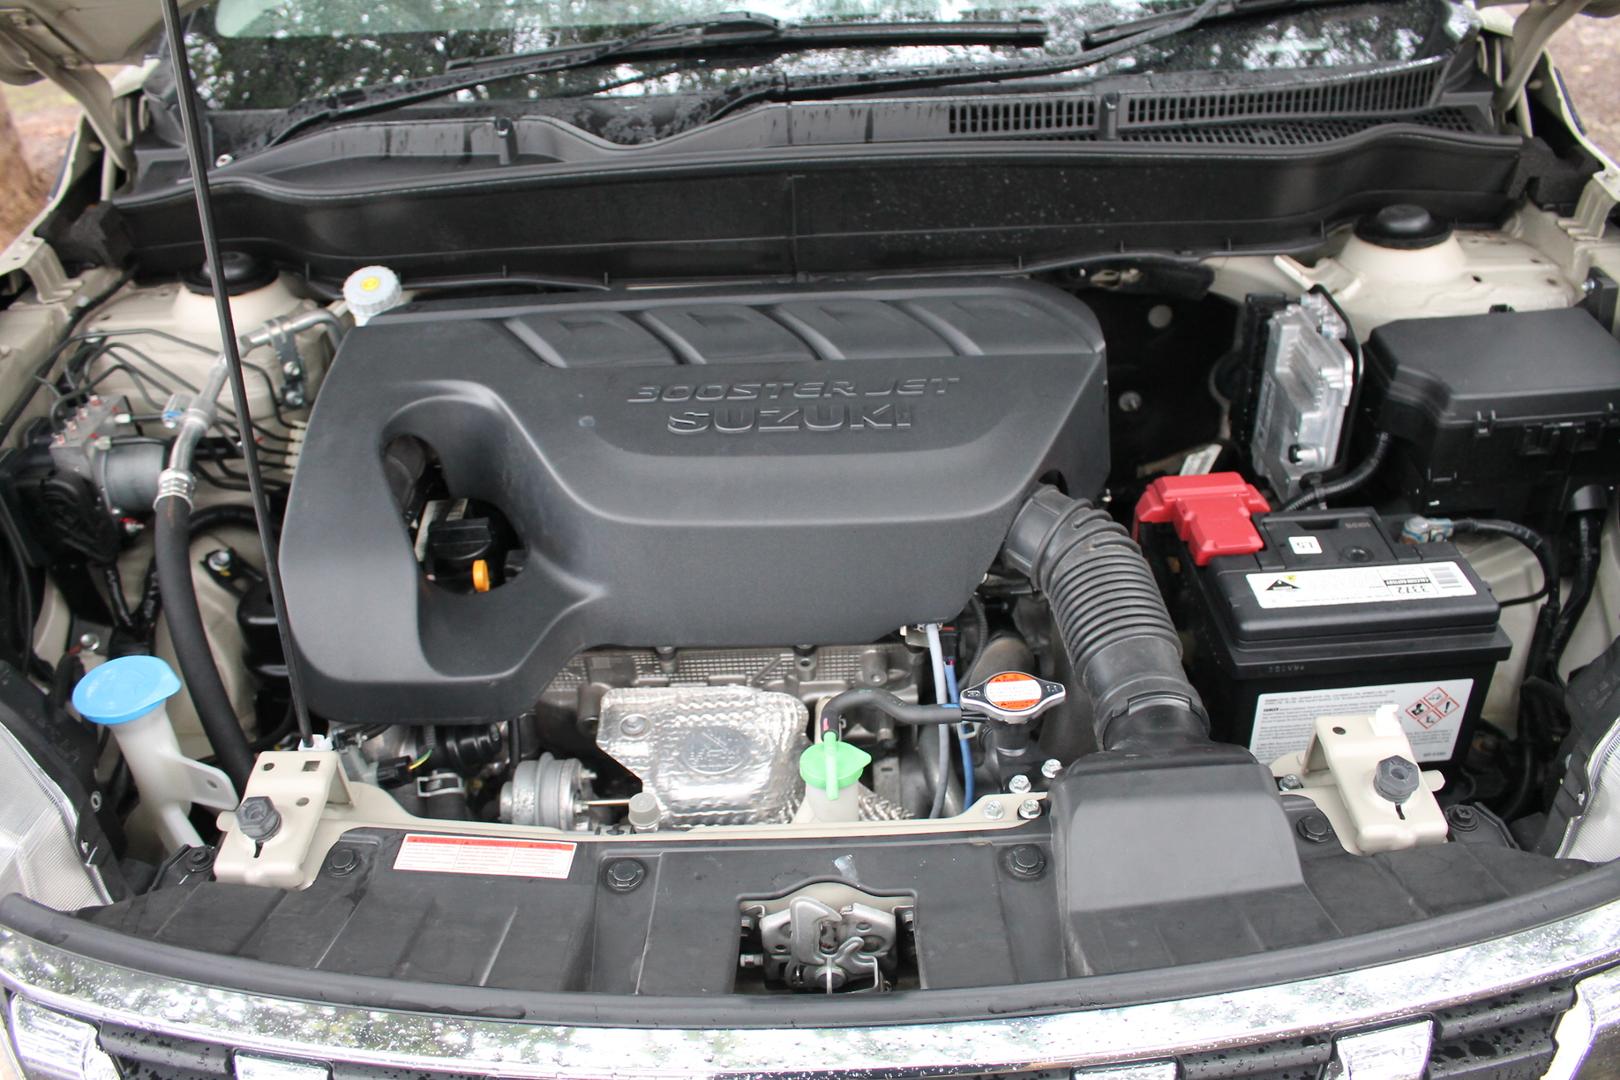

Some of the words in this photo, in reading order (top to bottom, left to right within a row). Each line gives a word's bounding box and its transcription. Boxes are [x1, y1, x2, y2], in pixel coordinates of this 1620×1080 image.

[627, 380, 857, 402] BOOSTER
[864, 377, 960, 396] JET
[667, 404, 912, 433] SUZUKI
